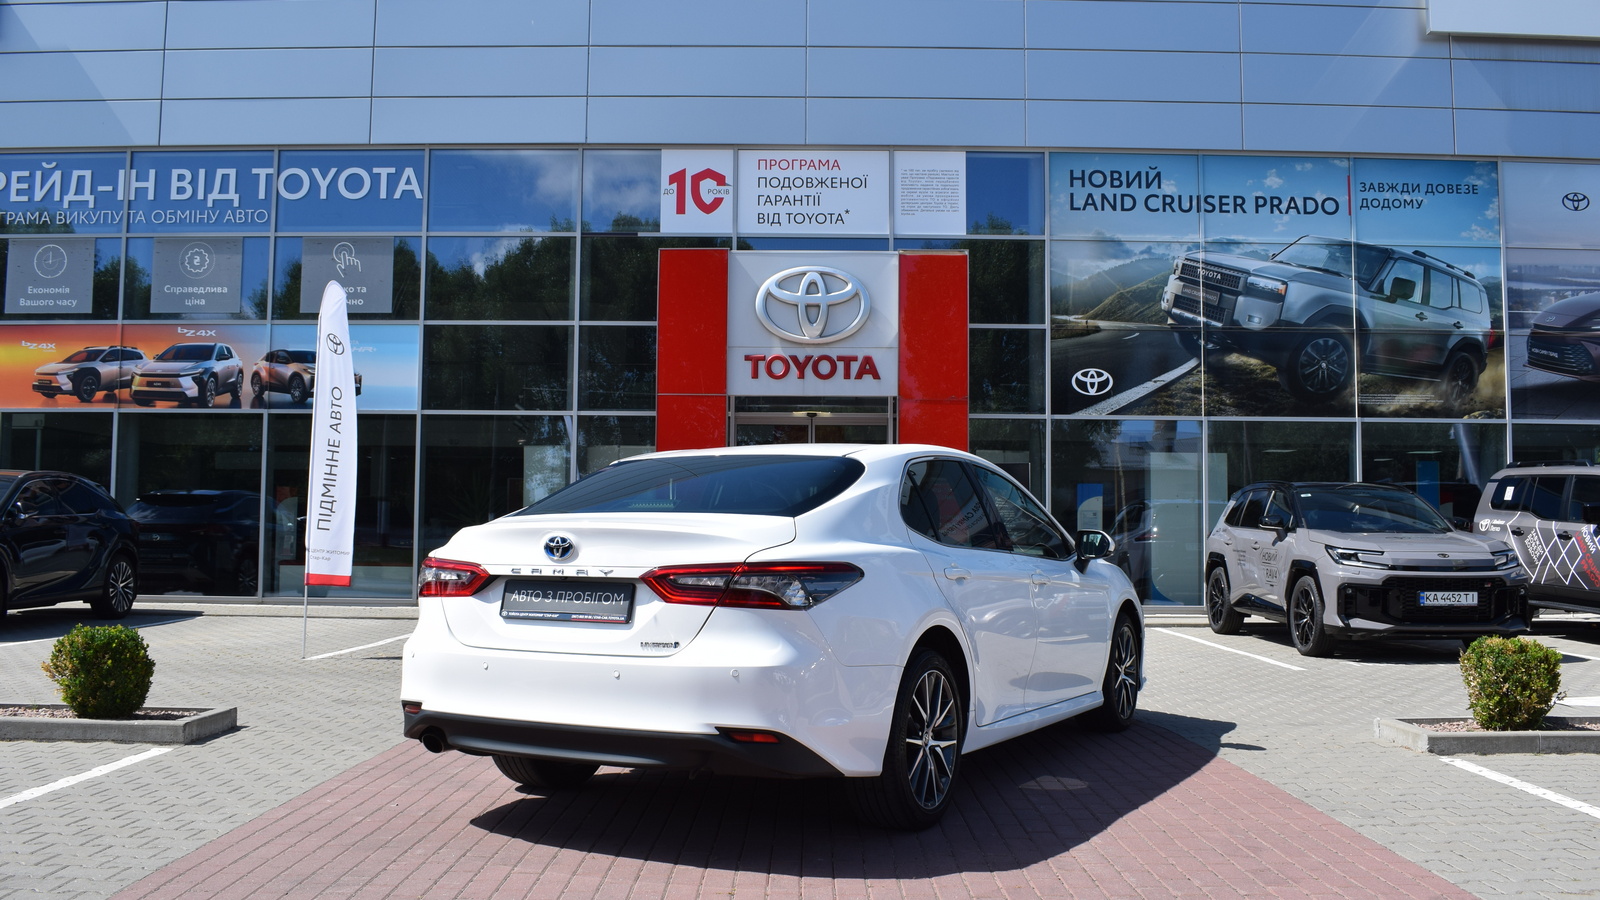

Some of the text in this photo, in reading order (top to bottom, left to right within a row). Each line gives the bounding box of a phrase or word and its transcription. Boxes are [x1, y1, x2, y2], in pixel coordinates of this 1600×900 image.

[757, 158, 842, 171] ПРОГРАМА
[757, 174, 869, 191] ПОДОВЖЕНОЇ
[1069, 165, 1162, 190] НОВИЙ
[170, 168, 240, 208] ВІД
[251, 166, 423, 201] TOYOTA
[663, 188, 675, 196] ДО
[707, 188, 730, 196] РОКІВ
[1359, 182, 1479, 196] ЗАВЖДИ ДОВЕЗЕ
[757, 192, 822, 207] ГАРАНТІЇ
[1069, 192, 1340, 216] LAND CRUISER PRADO
[1359, 197, 1424, 211] ДОДОМУ
[56, 210, 124, 225] ВИКУПУ
[128, 210, 147, 224] ТА
[151, 209, 220, 224] ОБМІНУ
[223, 209, 269, 223] АВТО
[757, 212, 782, 227] ВІД
[27, 286, 70, 294] Економія
[164, 285, 228, 295] Справедлива
[19, 298, 54, 307] Вашого
[185, 297, 206, 306] ціна
[744, 354, 881, 381] TOYOTA
[316, 386, 343, 531] ПІДМІННЕ АВТО
[1580, 524, 1597, 554] НОВИЙ
[510, 589, 543, 603] АВТО
[555, 591, 625, 606] ПРОБІГОМ
[1425, 593, 1439, 603] KA
[1440, 593, 1462, 603] 4452
